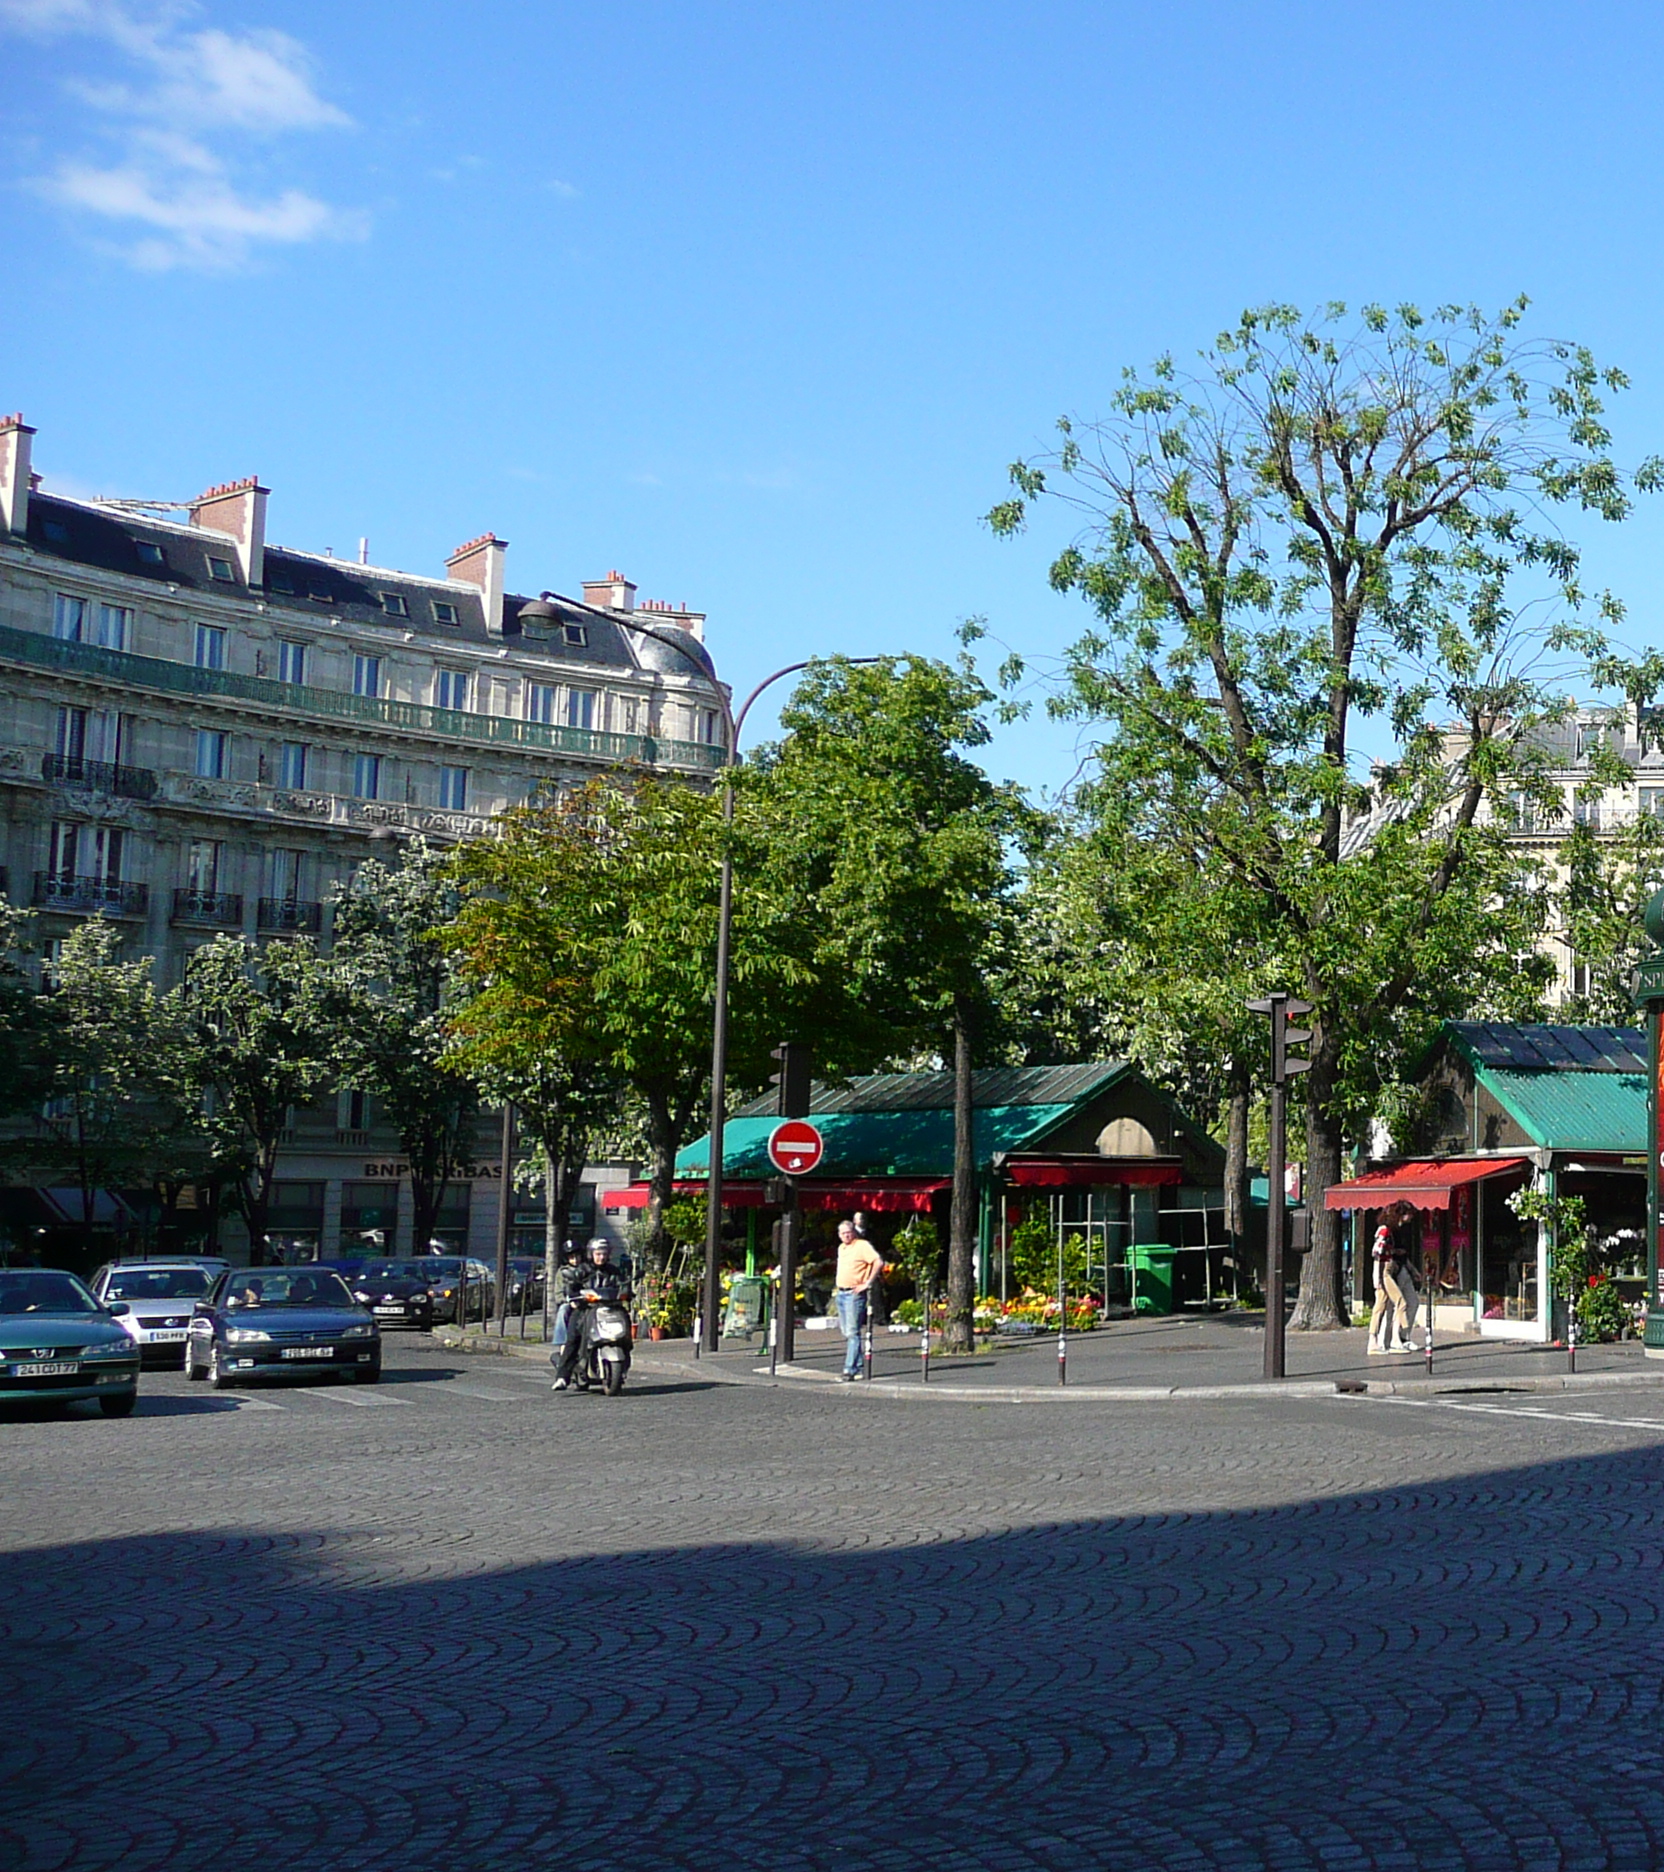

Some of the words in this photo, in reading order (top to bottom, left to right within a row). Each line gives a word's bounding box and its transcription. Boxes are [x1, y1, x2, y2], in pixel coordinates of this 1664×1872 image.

[364, 1163, 409, 1177] BNP
[411, 1164, 503, 1179] RIBAS
[20, 1364, 41, 1375] 241
[63, 1363, 77, 1374] 77
